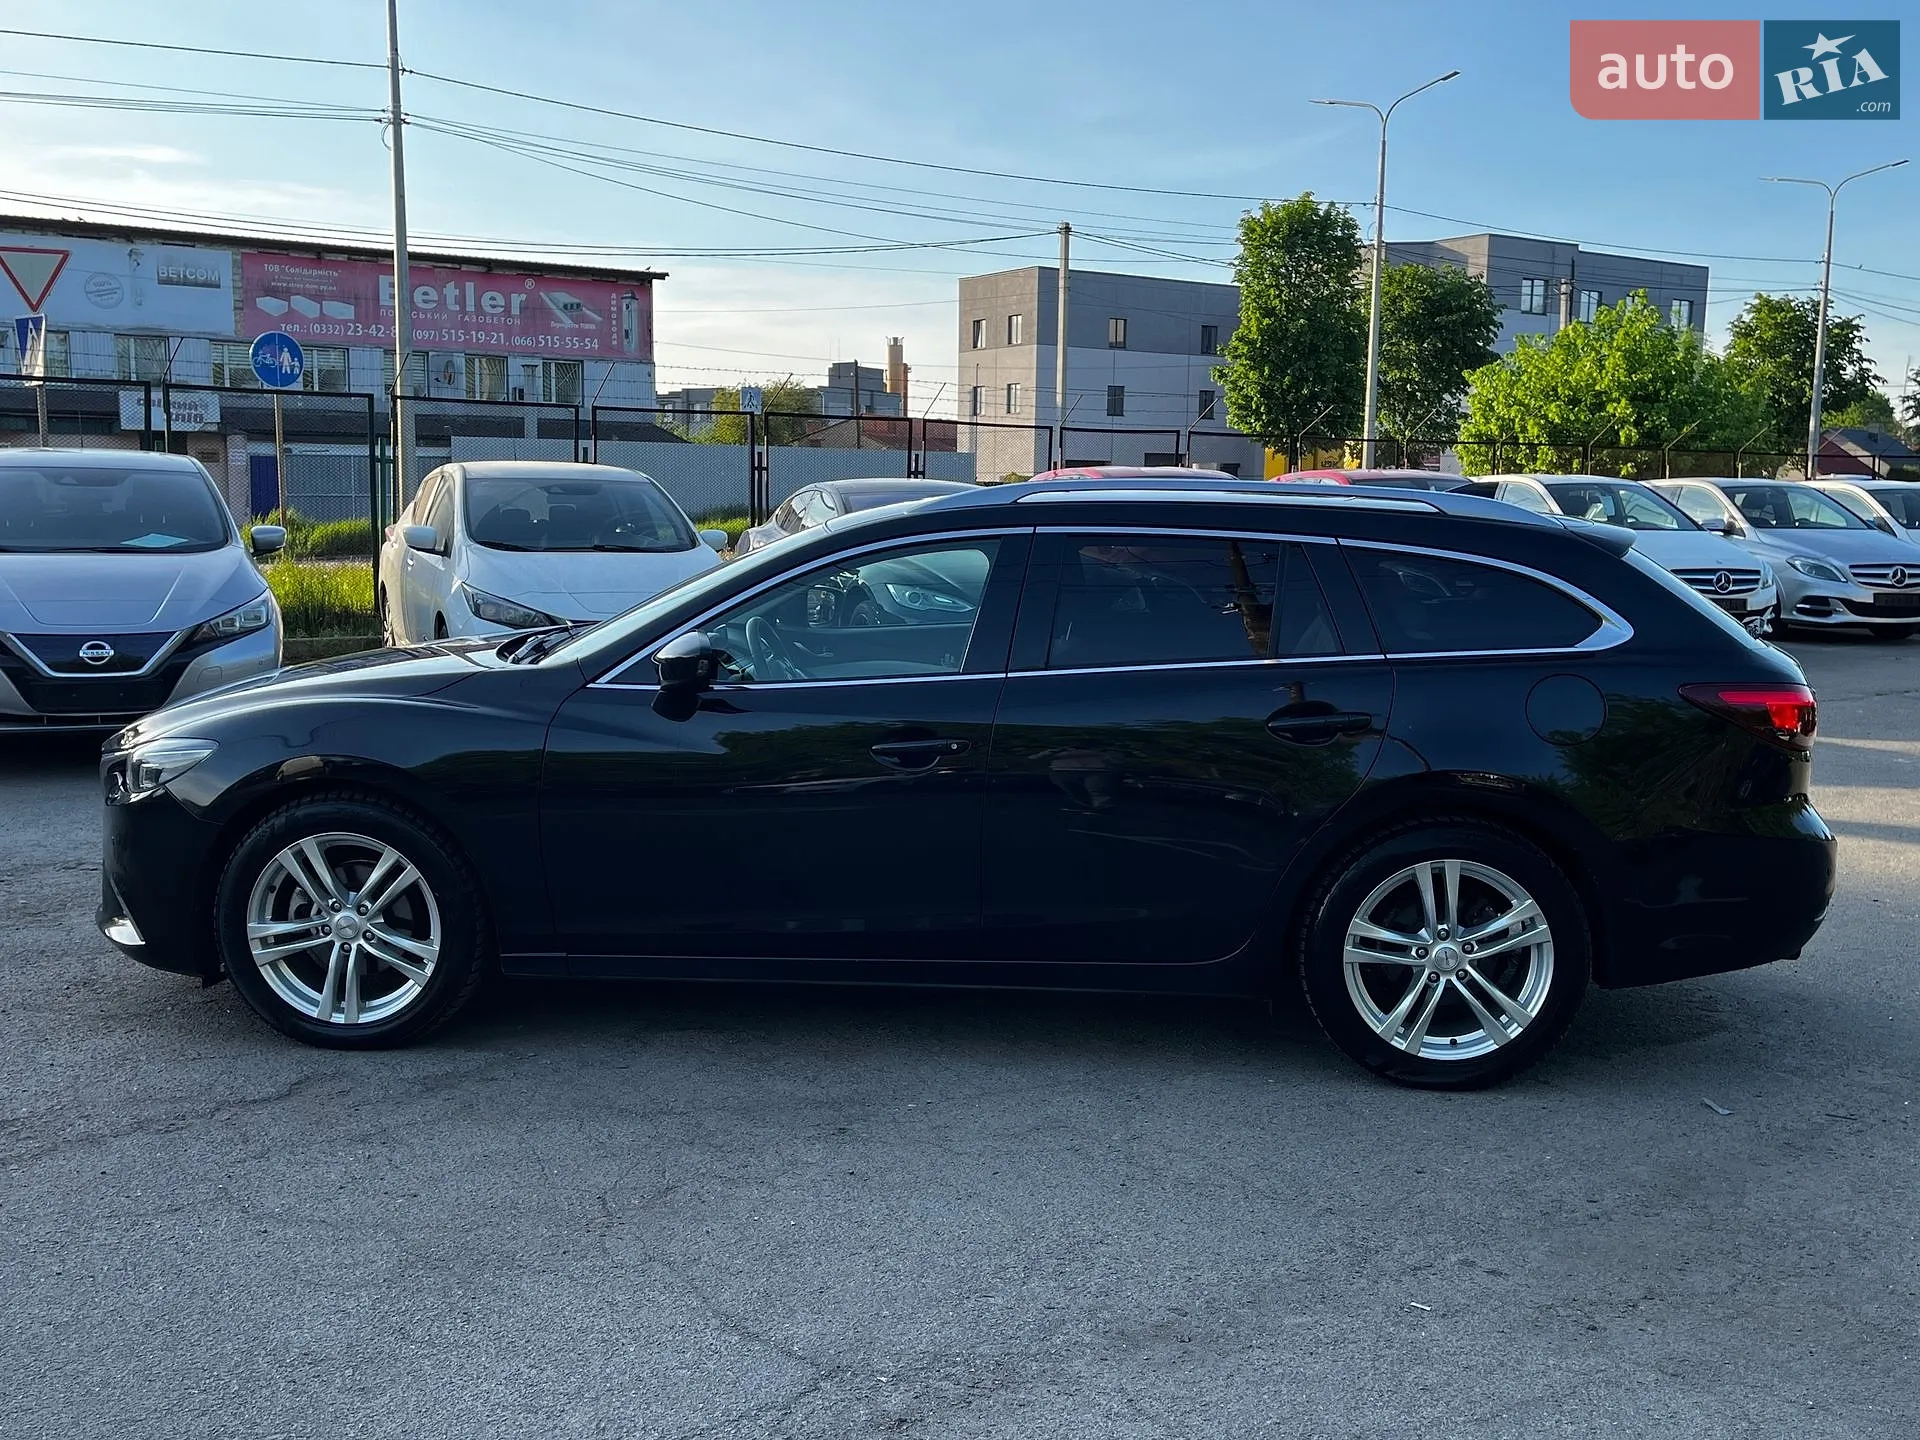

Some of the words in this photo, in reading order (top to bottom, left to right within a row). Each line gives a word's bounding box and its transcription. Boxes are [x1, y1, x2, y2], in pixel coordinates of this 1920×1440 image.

[158, 264, 219, 281] BETCOM
[264, 263, 280, 273] ТОВ
[380, 308, 448, 321] ПОСЬКИЙ
[458, 313, 521, 325] ГАЗОБЕТОН
[280, 323, 307, 333] тел.:
[309, 322, 344, 337] (0332)
[412, 328, 439, 342] (097)
[511, 335, 536, 348] (066)
[538, 335, 599, 351] 515-55-54
